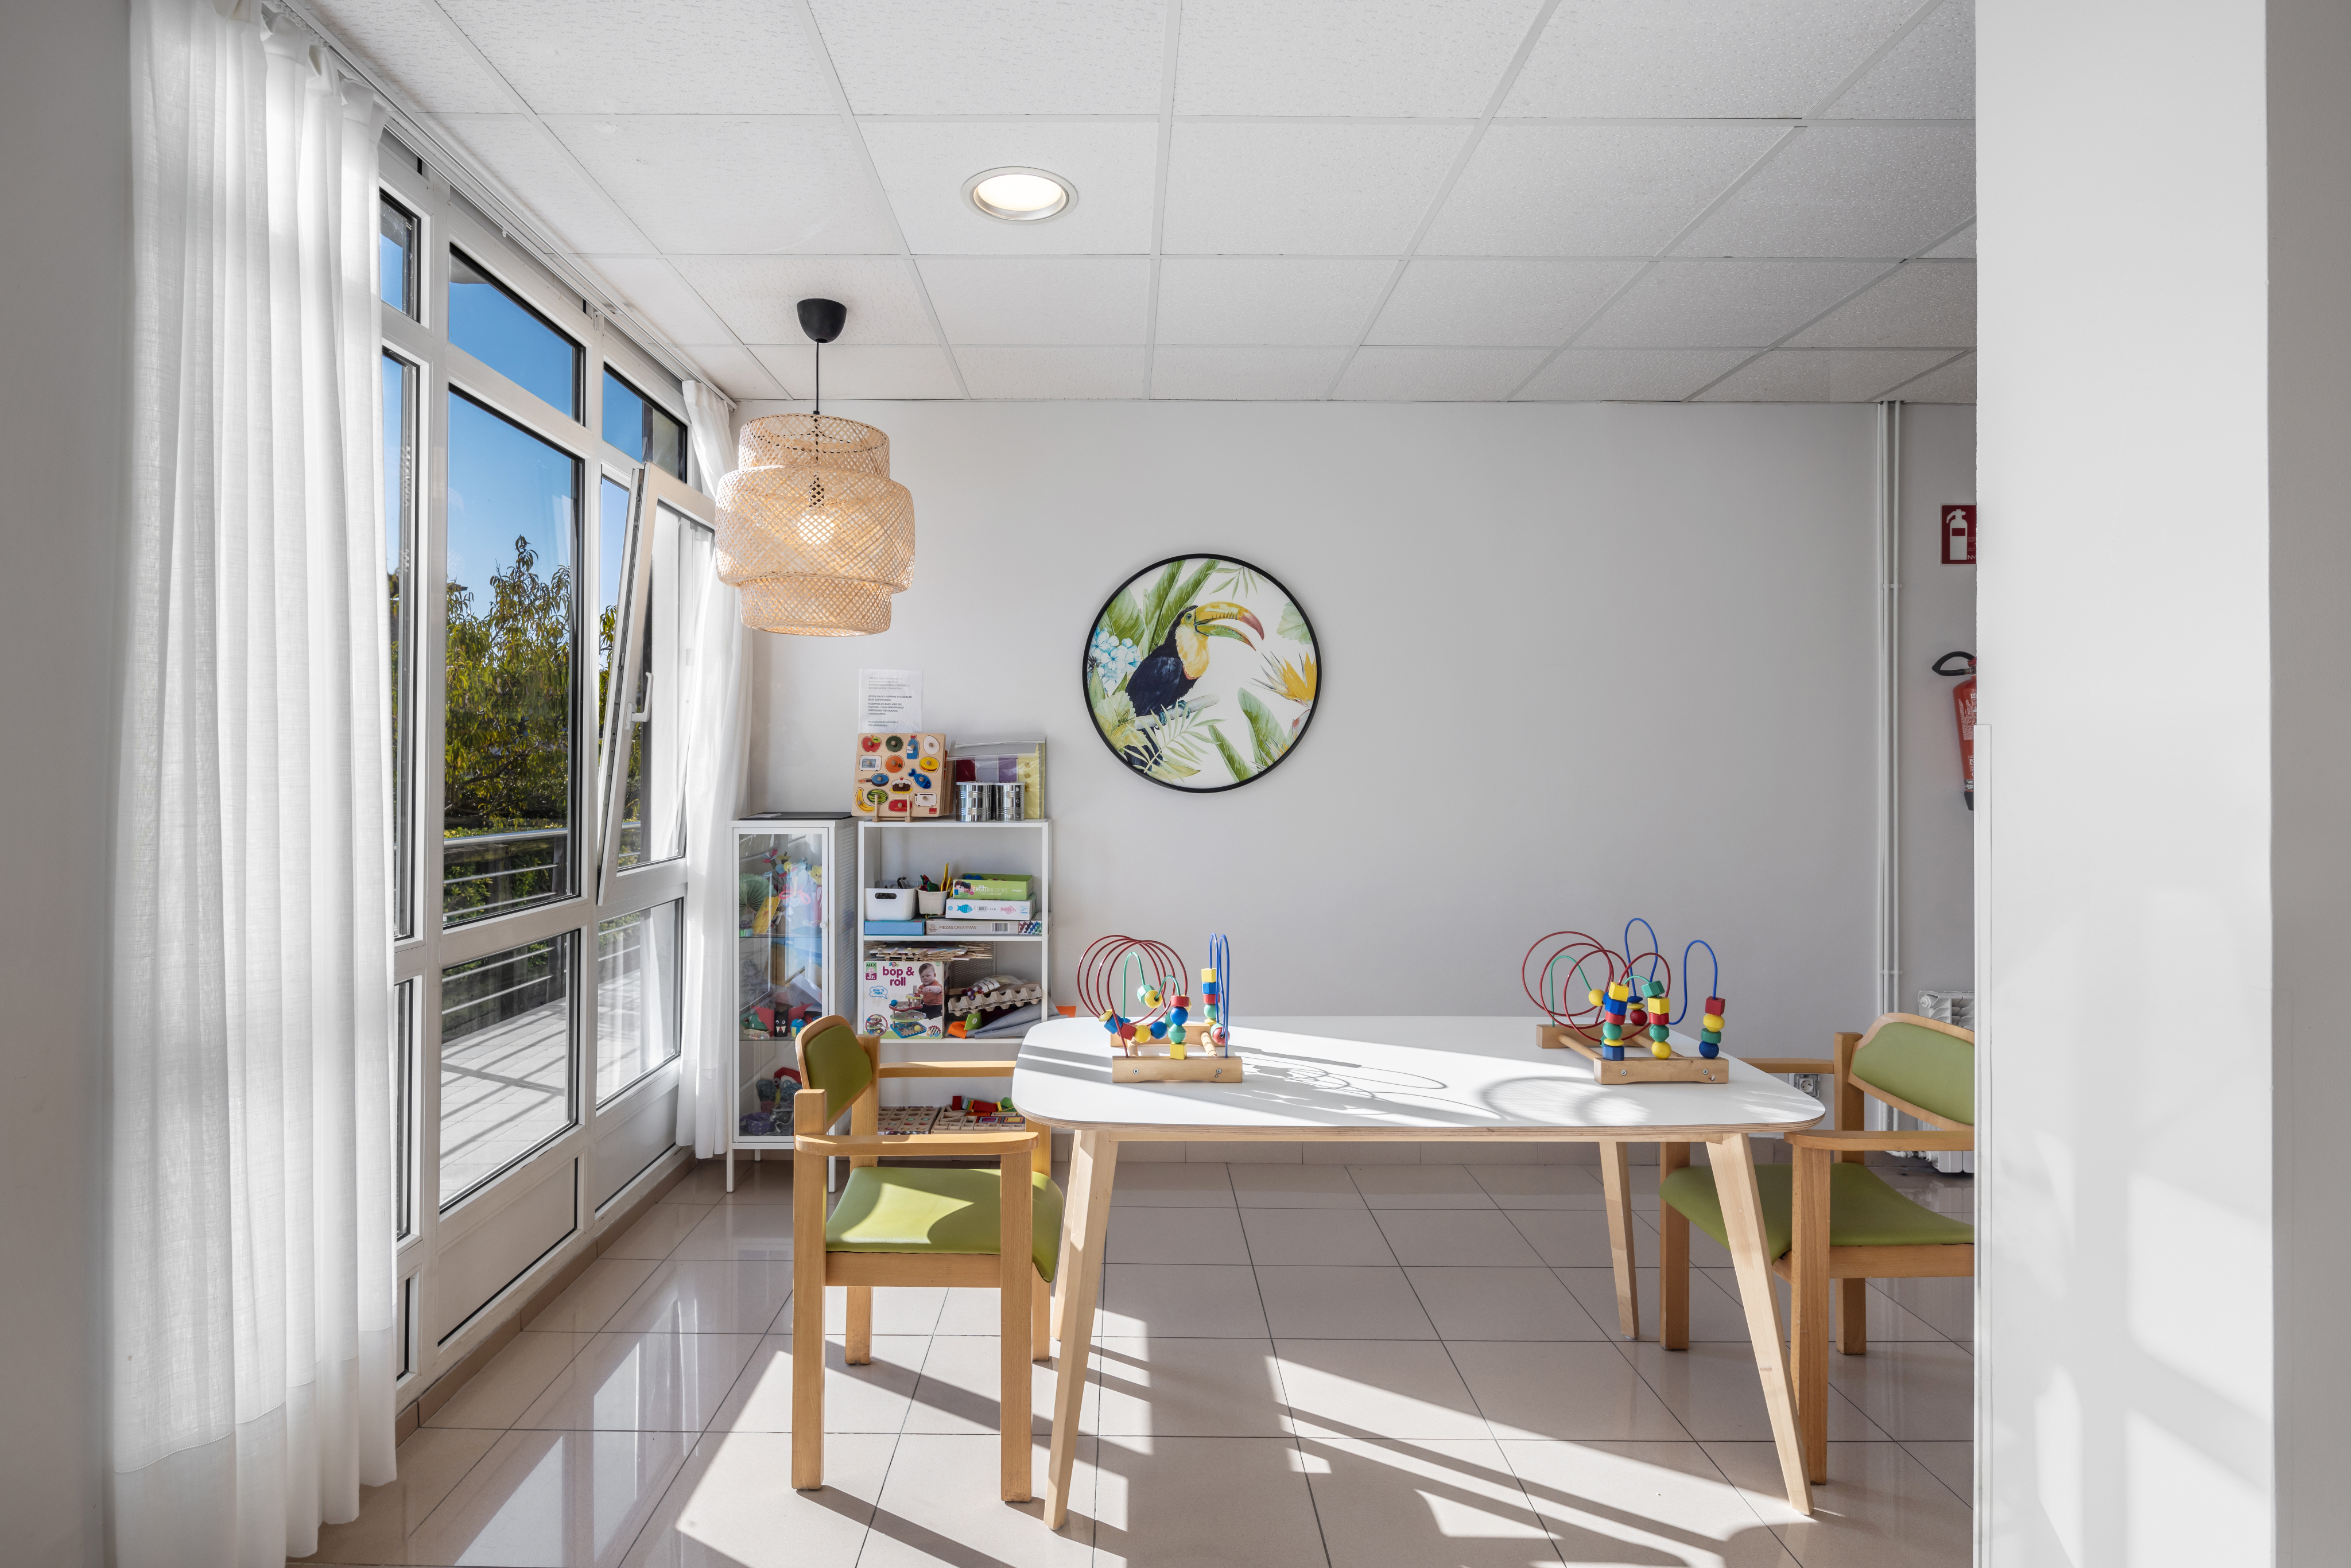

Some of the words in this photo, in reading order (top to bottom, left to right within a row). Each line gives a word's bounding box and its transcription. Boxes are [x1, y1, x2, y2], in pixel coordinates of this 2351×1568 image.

[883, 966, 903, 978] bop
[906, 967, 914, 976] &
[890, 976, 906, 986] roll
